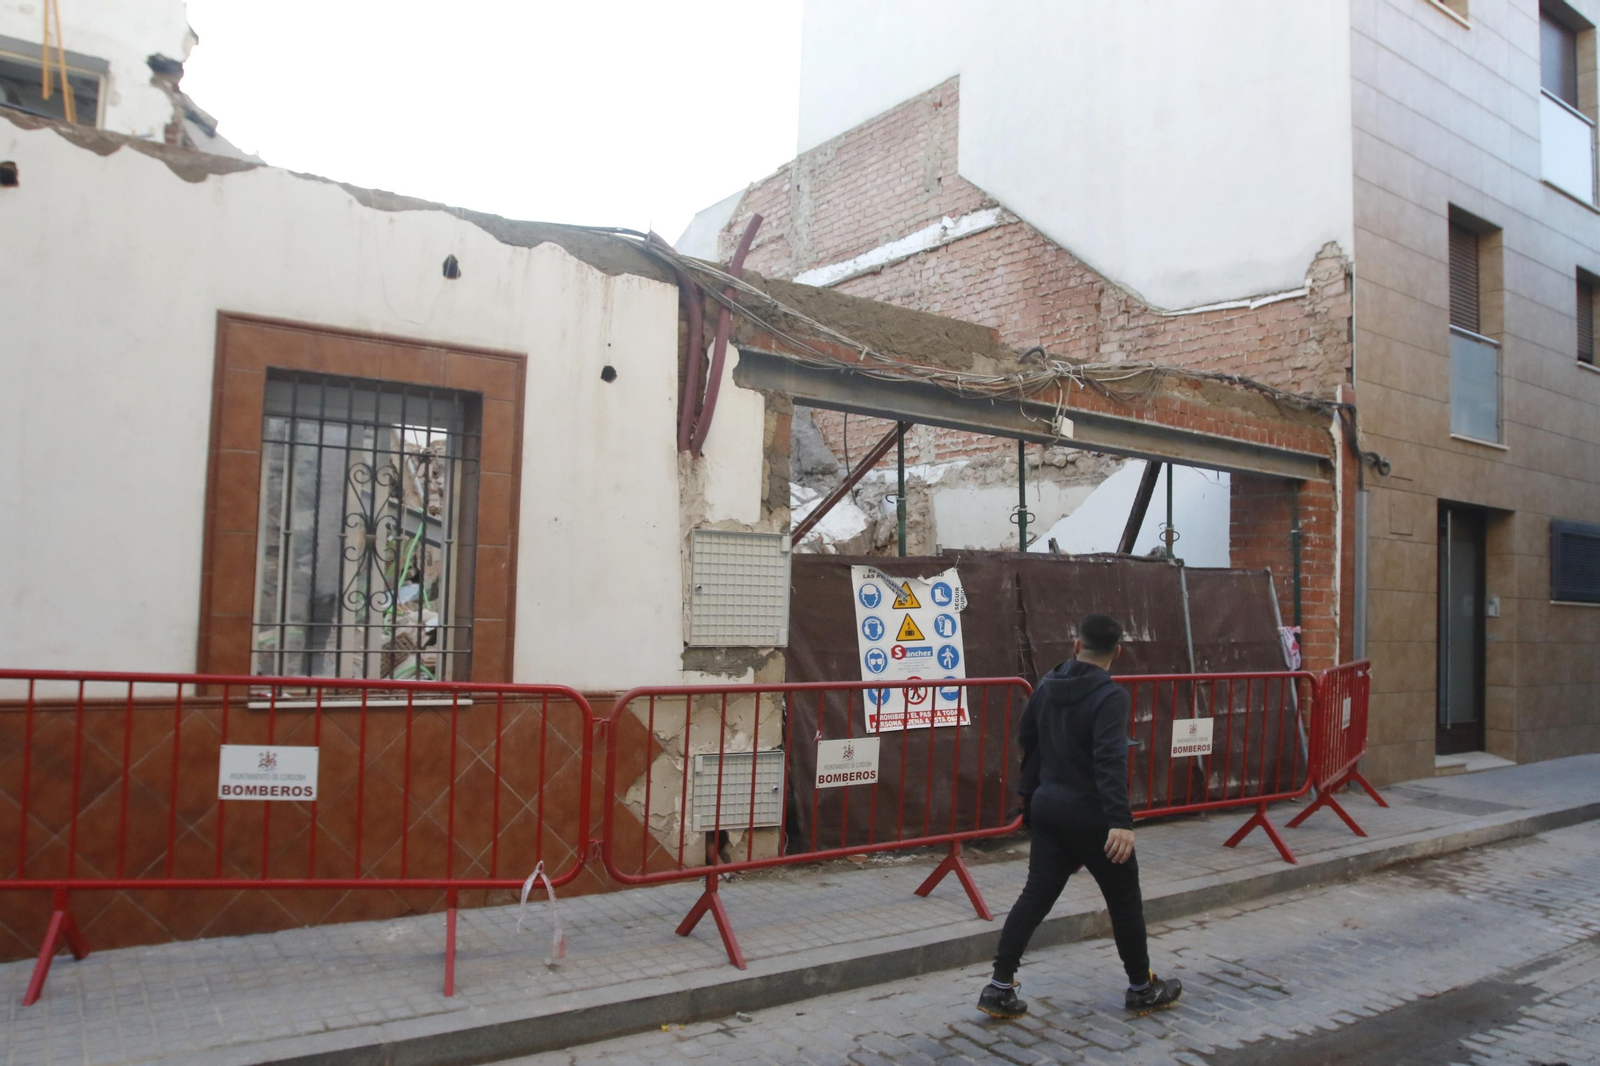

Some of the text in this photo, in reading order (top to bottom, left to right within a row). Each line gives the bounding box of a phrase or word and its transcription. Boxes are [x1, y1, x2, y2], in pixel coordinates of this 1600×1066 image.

[894, 647, 932, 659] Sánchez
[1173, 744, 1211, 754] BOMBEROS
[818, 770, 876, 784] BOMBEROS
[221, 785, 313, 797] BOMBEROS
